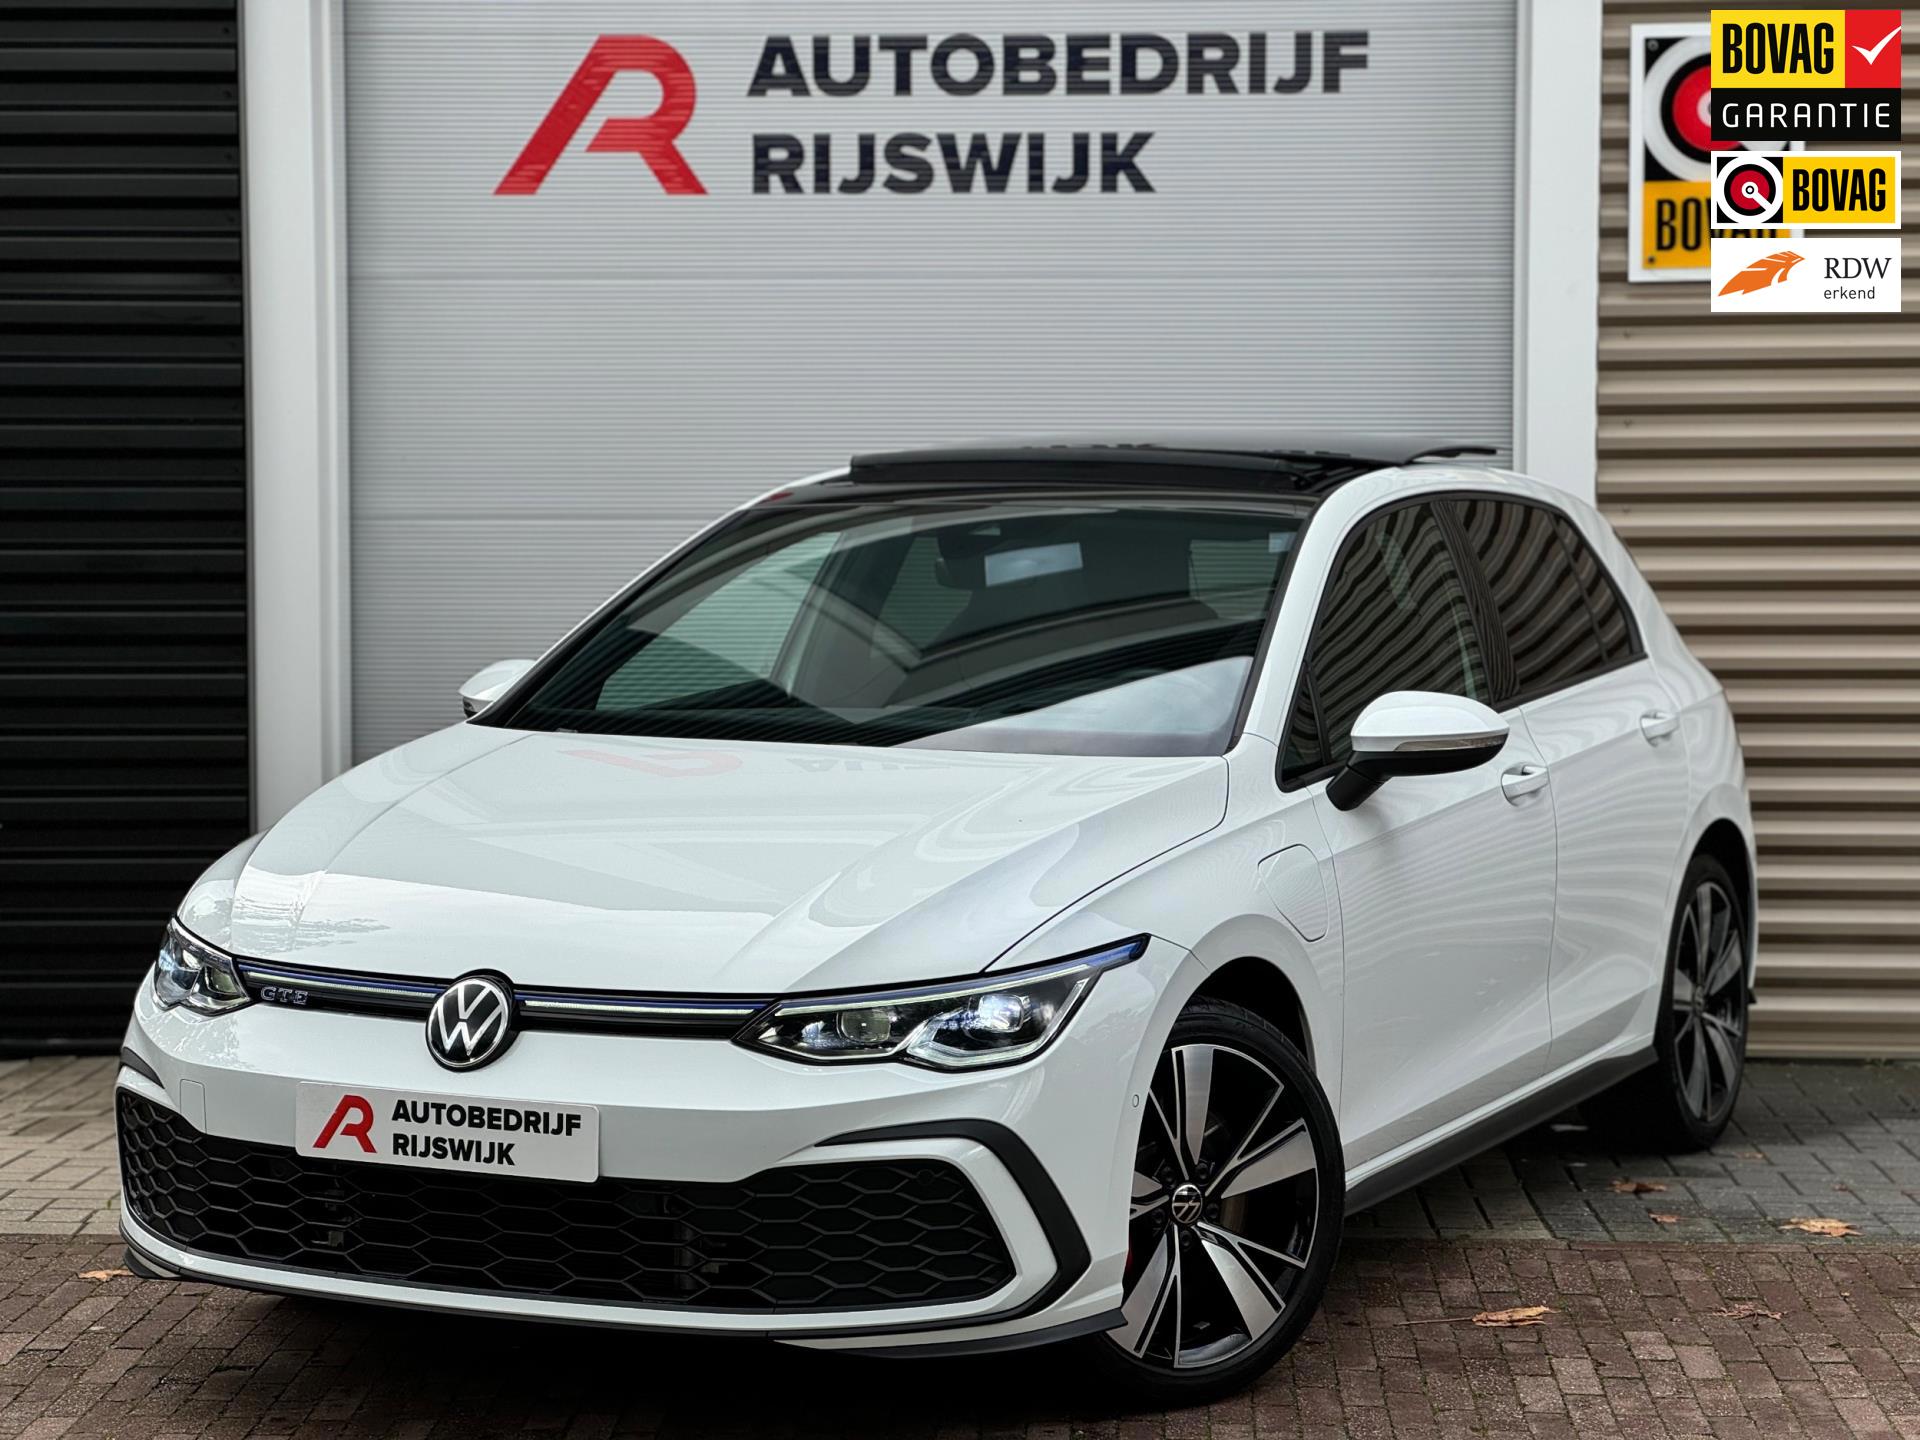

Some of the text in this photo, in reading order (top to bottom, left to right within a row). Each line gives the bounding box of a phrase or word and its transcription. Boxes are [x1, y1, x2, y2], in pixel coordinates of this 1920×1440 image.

[747, 31, 1369, 97] AUTOBEDRIJF
[752, 132, 1156, 195] RIJSWIJK
[260, 986, 309, 1005] GTE
[391, 1099, 582, 1137] AUTOBEDRIJF
[392, 1133, 515, 1166] RIJSWIJK
